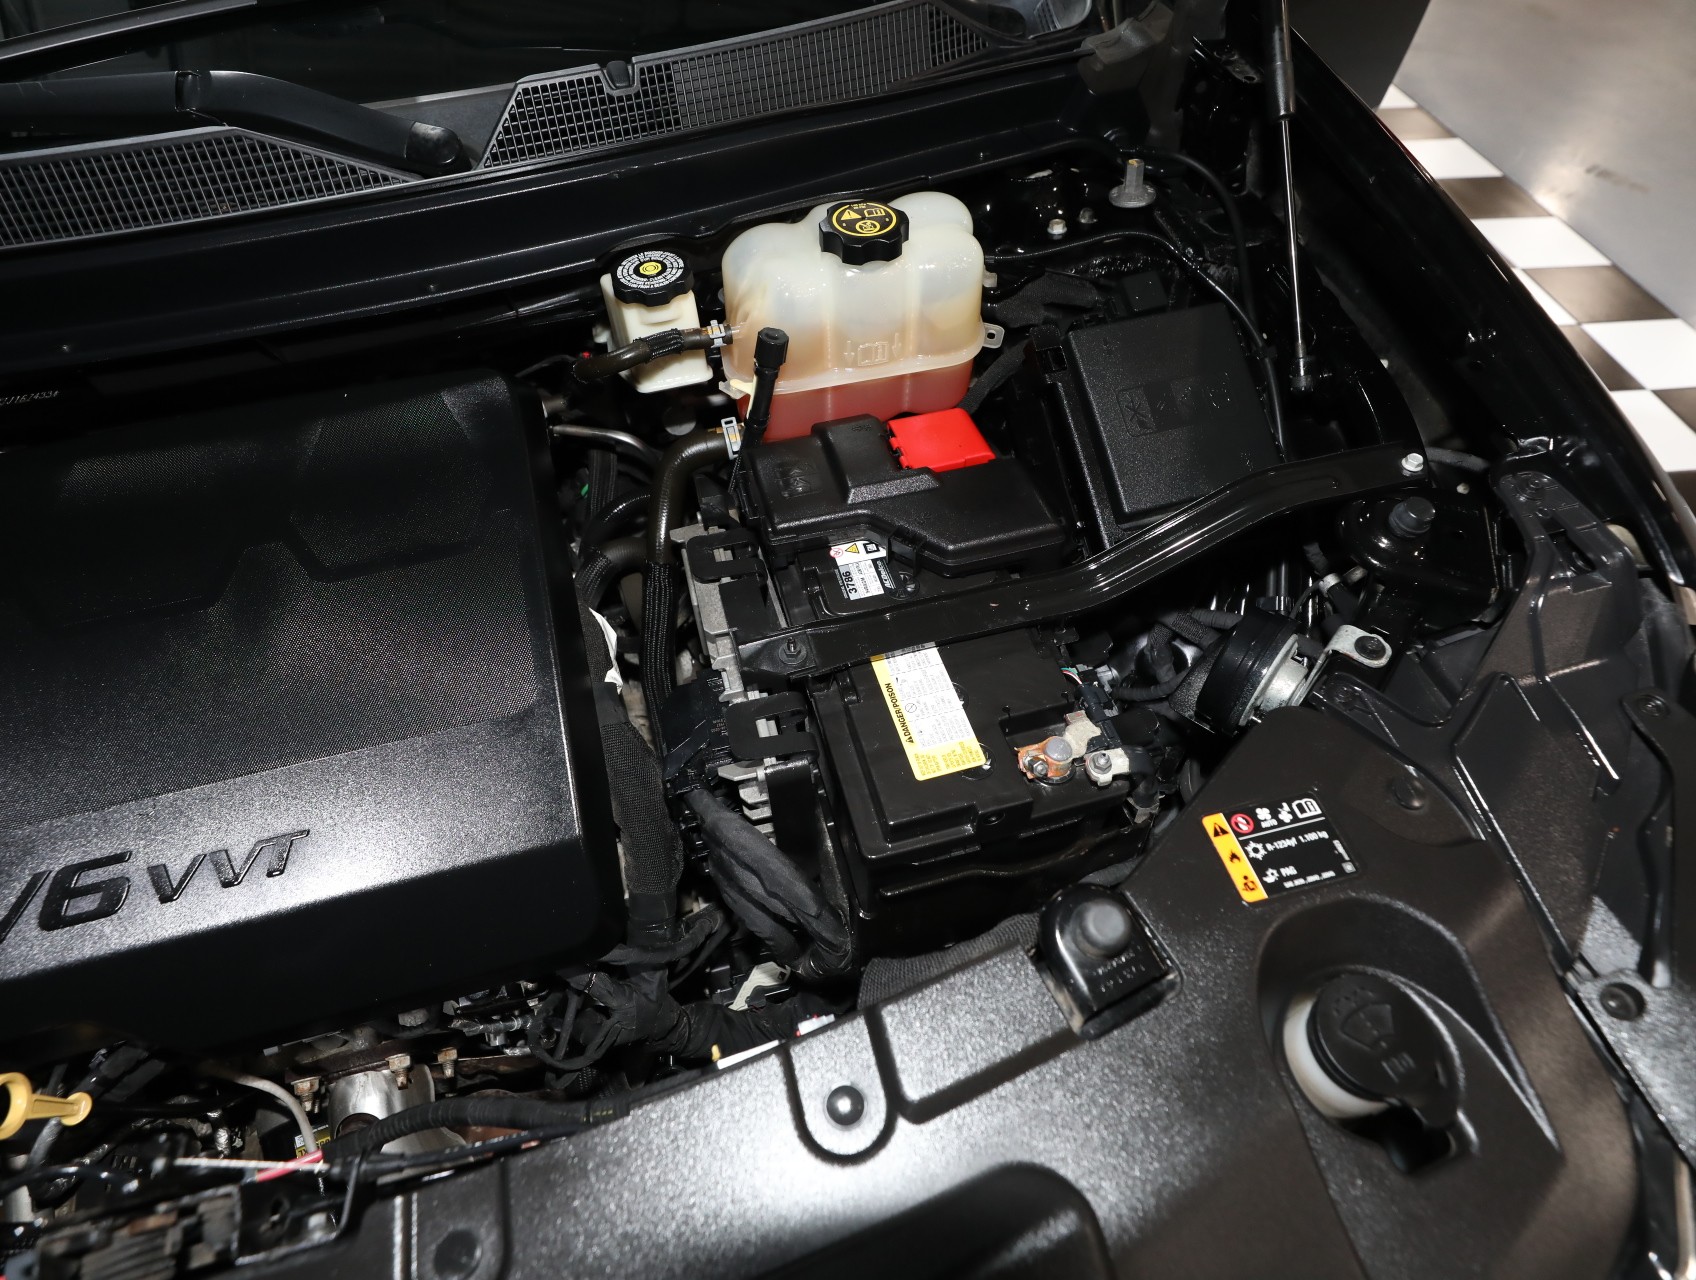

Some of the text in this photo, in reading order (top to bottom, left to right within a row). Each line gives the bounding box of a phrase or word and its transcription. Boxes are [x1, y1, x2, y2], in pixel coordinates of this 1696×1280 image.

[842, 571, 858, 594] 3786
[885, 682, 912, 737] DANGER/POISON
[147, 829, 310, 904] VVT
